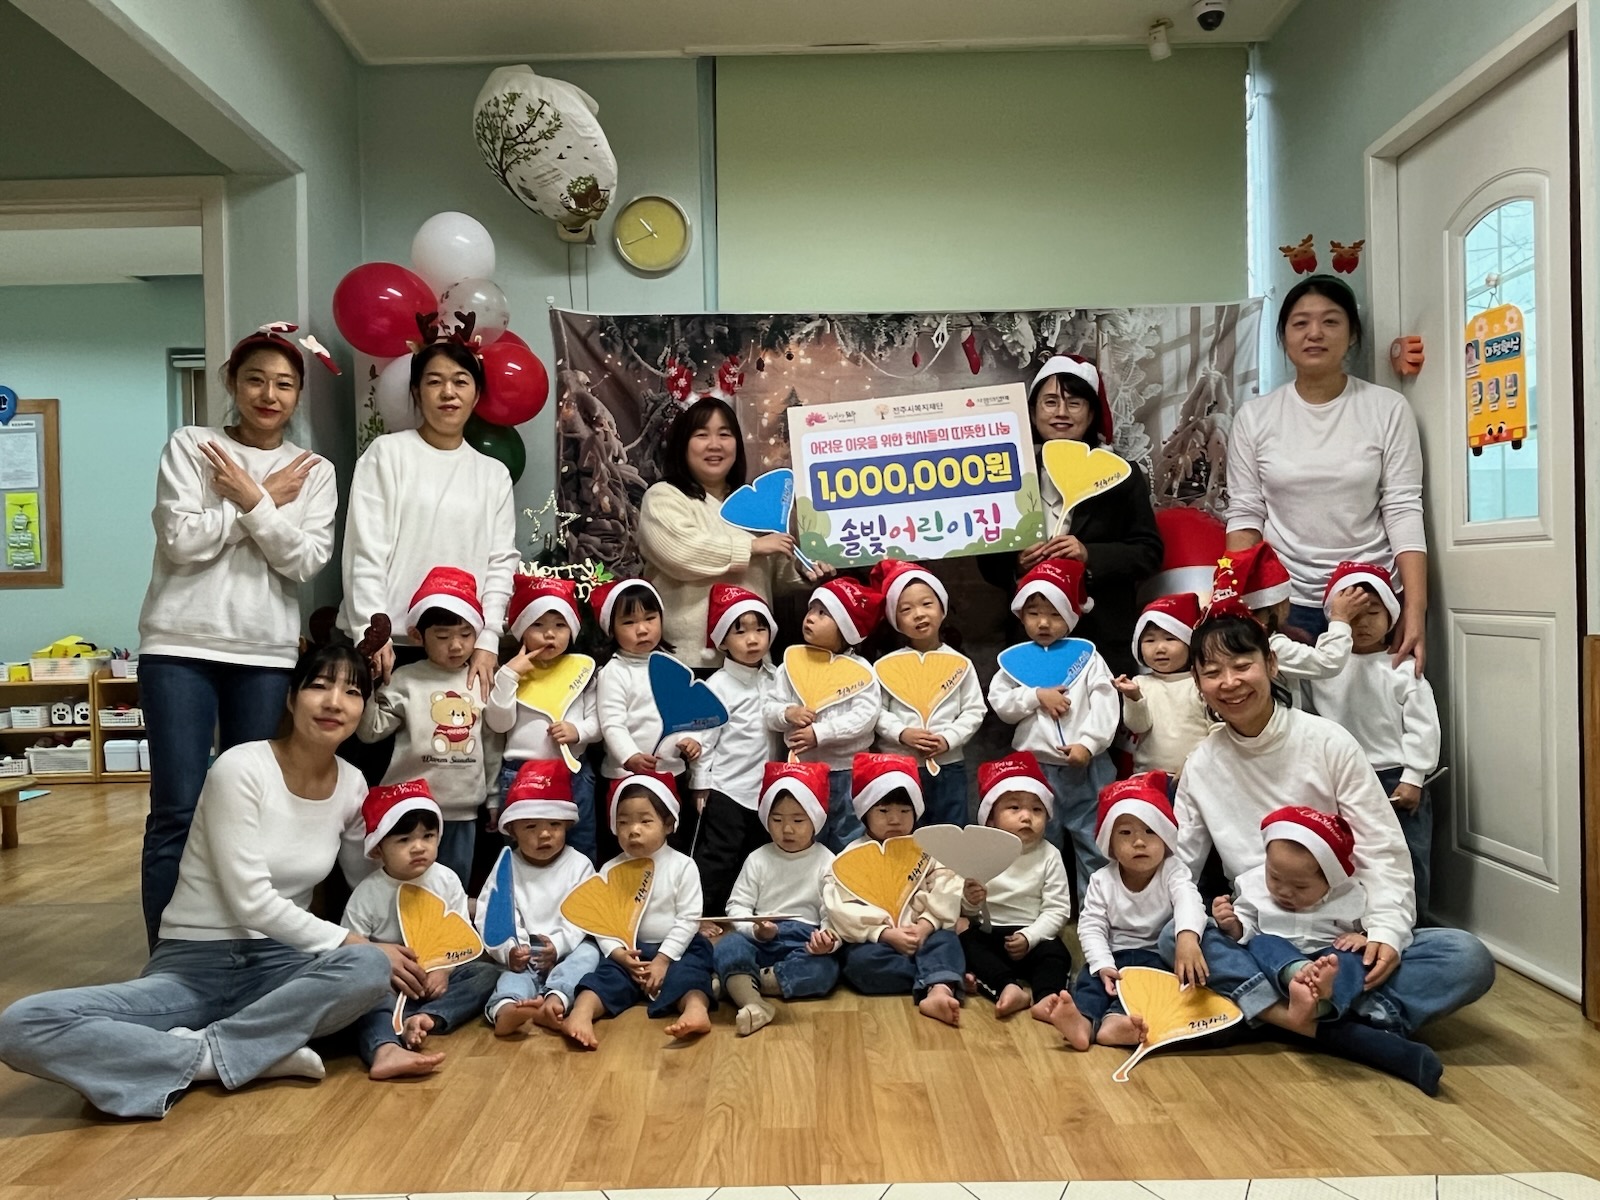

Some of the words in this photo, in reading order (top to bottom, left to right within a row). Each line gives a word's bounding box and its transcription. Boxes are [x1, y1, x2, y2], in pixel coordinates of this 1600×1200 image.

[810, 440, 843, 455] 어려운
[846, 436, 878, 452] 이웃을
[880, 433, 903, 447] 위한
[905, 427, 950, 445] 천사들의
[951, 424, 986, 441] 따뜻한
[989, 421, 1011, 437] 나눔
[817, 451, 1012, 503] 1,000,000원
[519, 557, 595, 580] Merry
